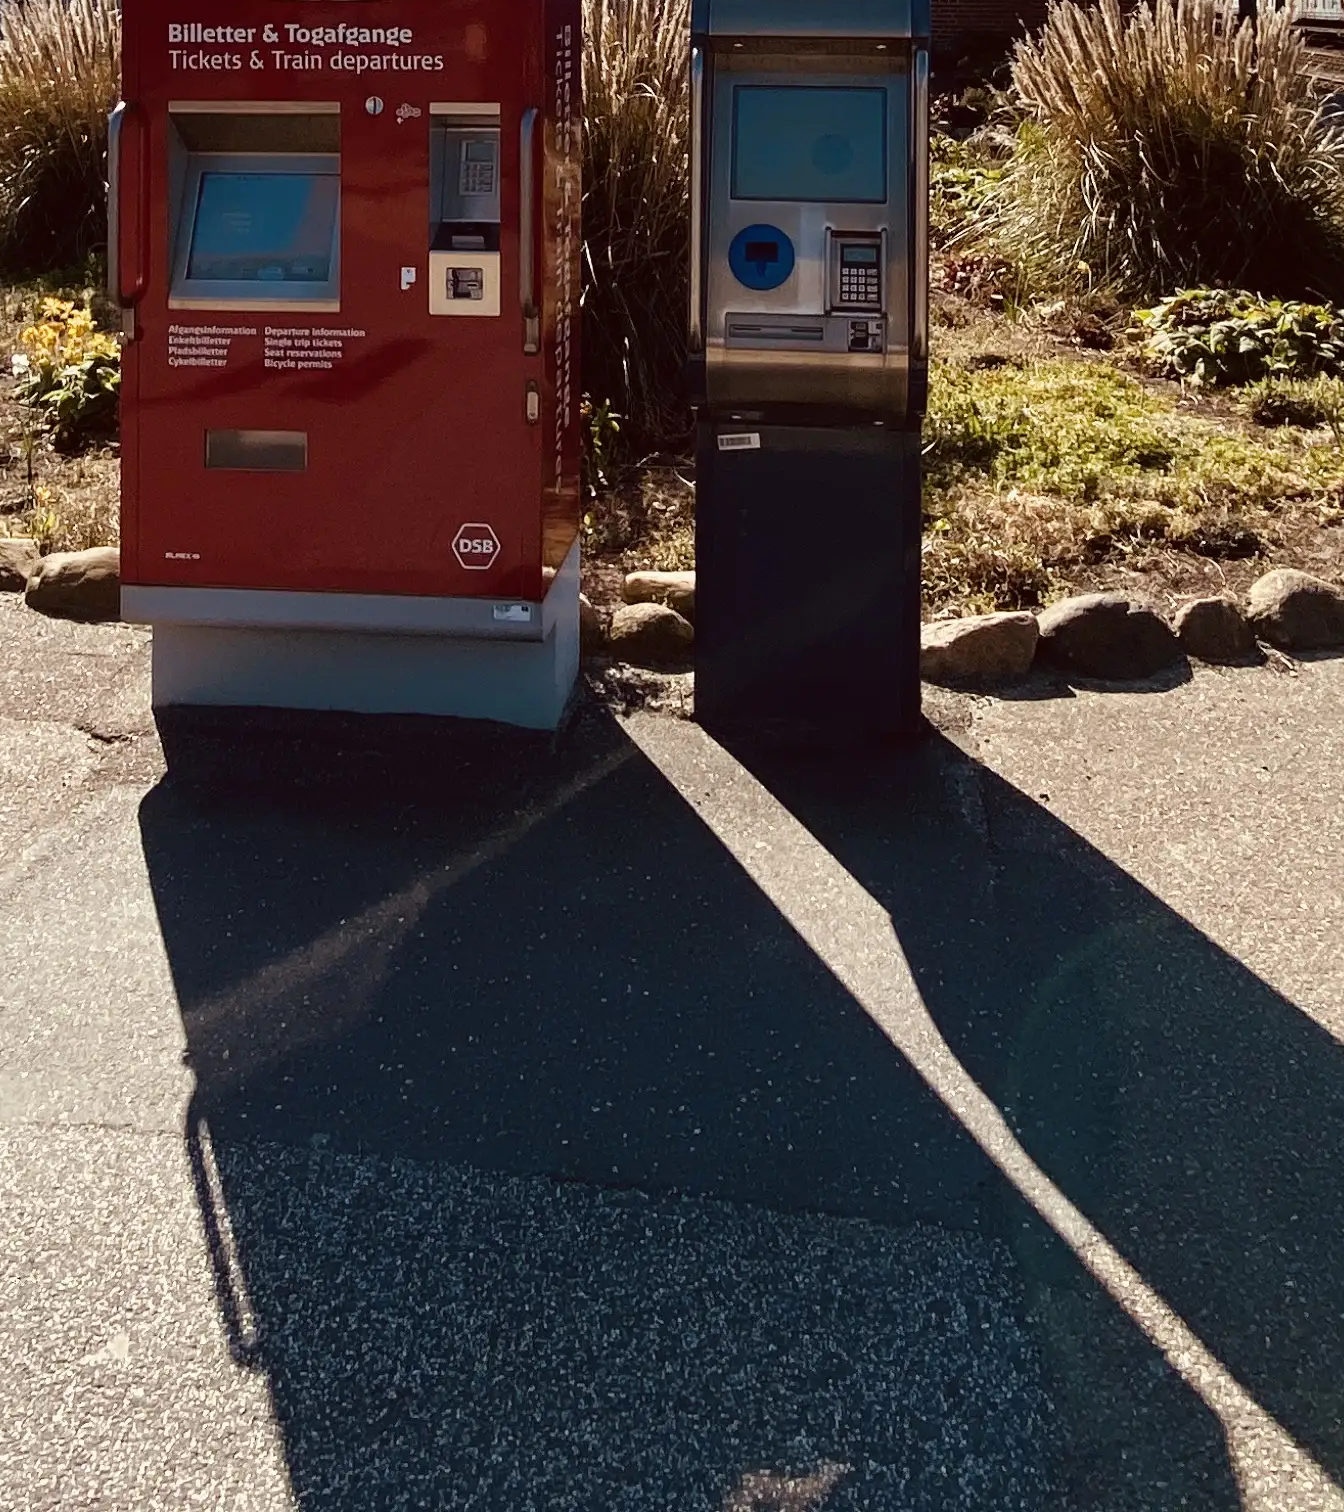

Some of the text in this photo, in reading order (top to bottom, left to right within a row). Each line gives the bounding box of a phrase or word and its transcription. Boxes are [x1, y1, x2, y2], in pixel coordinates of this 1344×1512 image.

[168, 23, 413, 47] Billetter & Togafgange
[169, 50, 444, 75] Tickets & Train departures
[264, 326, 366, 337] Departure information
[264, 337, 343, 348] Single trip tickets
[264, 348, 343, 359] Seat reservations
[264, 358, 333, 369] Bicycle permits
[459, 538, 494, 554] DSB
